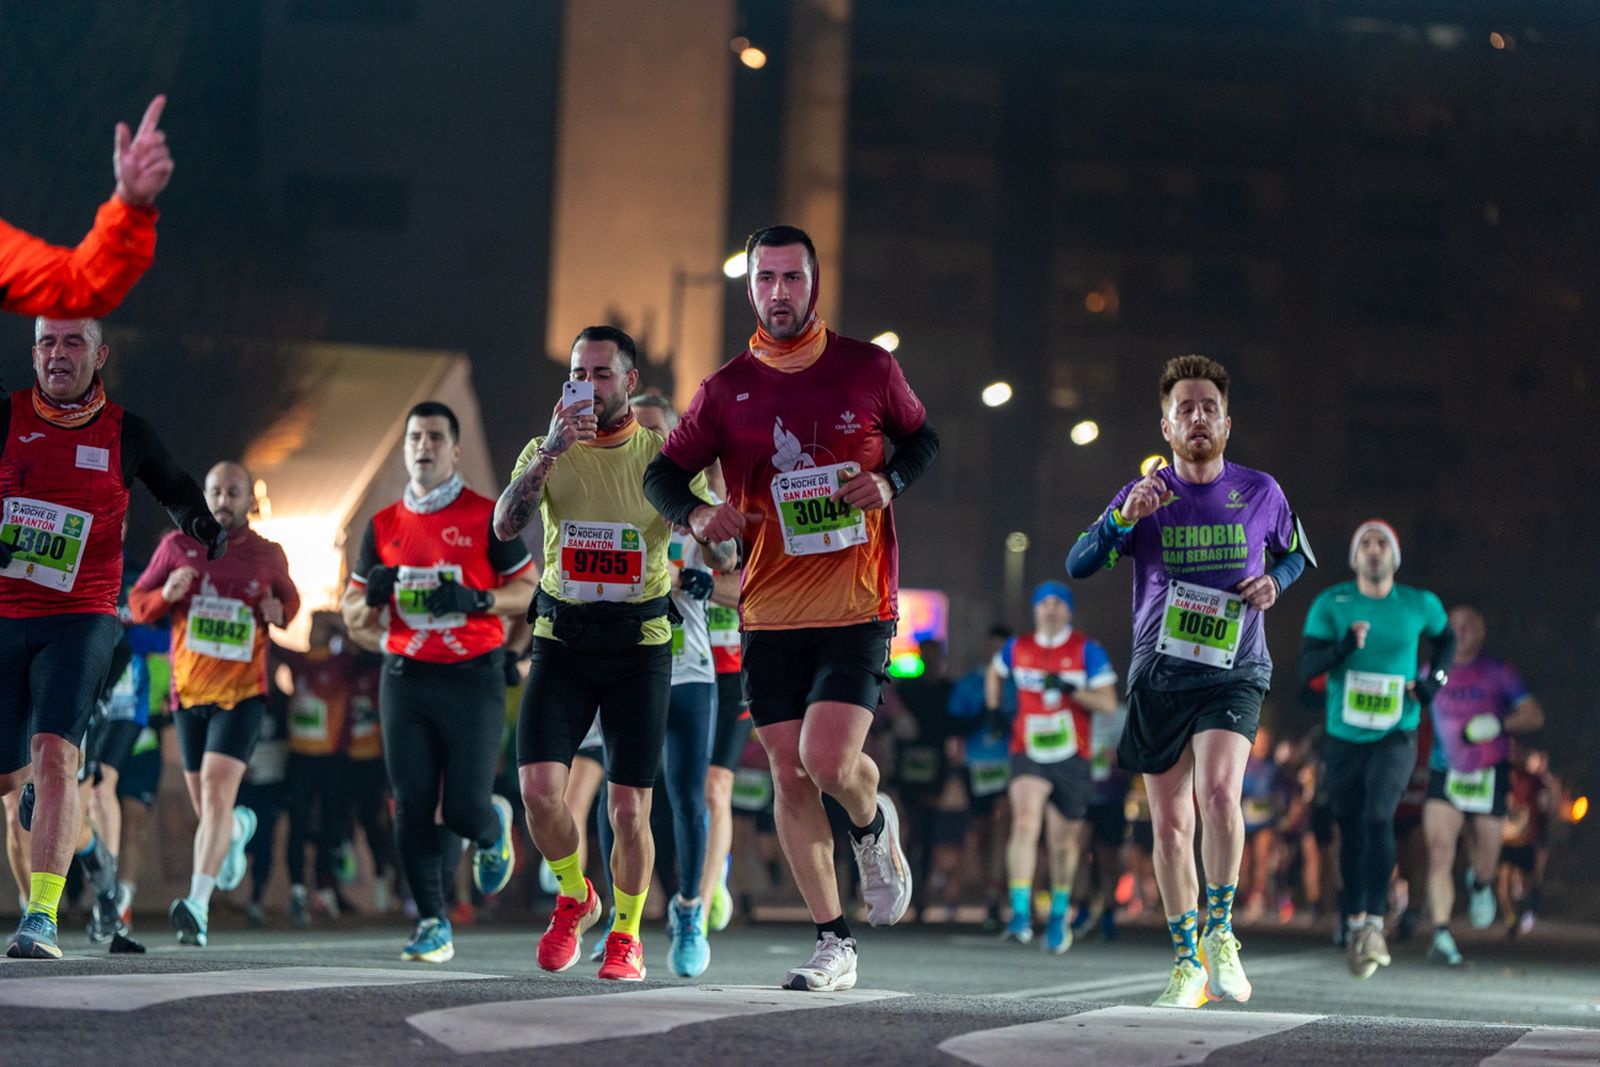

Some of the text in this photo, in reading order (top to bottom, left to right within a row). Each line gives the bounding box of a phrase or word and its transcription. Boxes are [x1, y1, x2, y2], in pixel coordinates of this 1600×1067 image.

[791, 477, 818, 490] NOCHE
[819, 475, 829, 485] DE
[783, 486, 831, 501] SAN ANTÓN
[19, 506, 46, 518] NOCHE
[46, 511, 58, 521] DE
[793, 497, 851, 526] 3044
[10, 515, 24, 524] SAN
[24, 516, 55, 531] ANTÓN
[13, 526, 67, 560] 1300
[577, 530, 614, 540] NOCHE DE
[1161, 523, 1247, 548] BEHOBIA
[567, 539, 584, 548] SAN
[585, 540, 614, 550] ANTÓN
[574, 550, 628, 575] 9755
[1162, 545, 1248, 564] SAN SEBASTIÁN
[1174, 599, 1218, 615] SAN ANTÓN
[1185, 592, 1209, 604] NOCHE
[1210, 597, 1220, 606] DE
[198, 619, 246, 640] 13842
[1178, 610, 1228, 642] 1060
